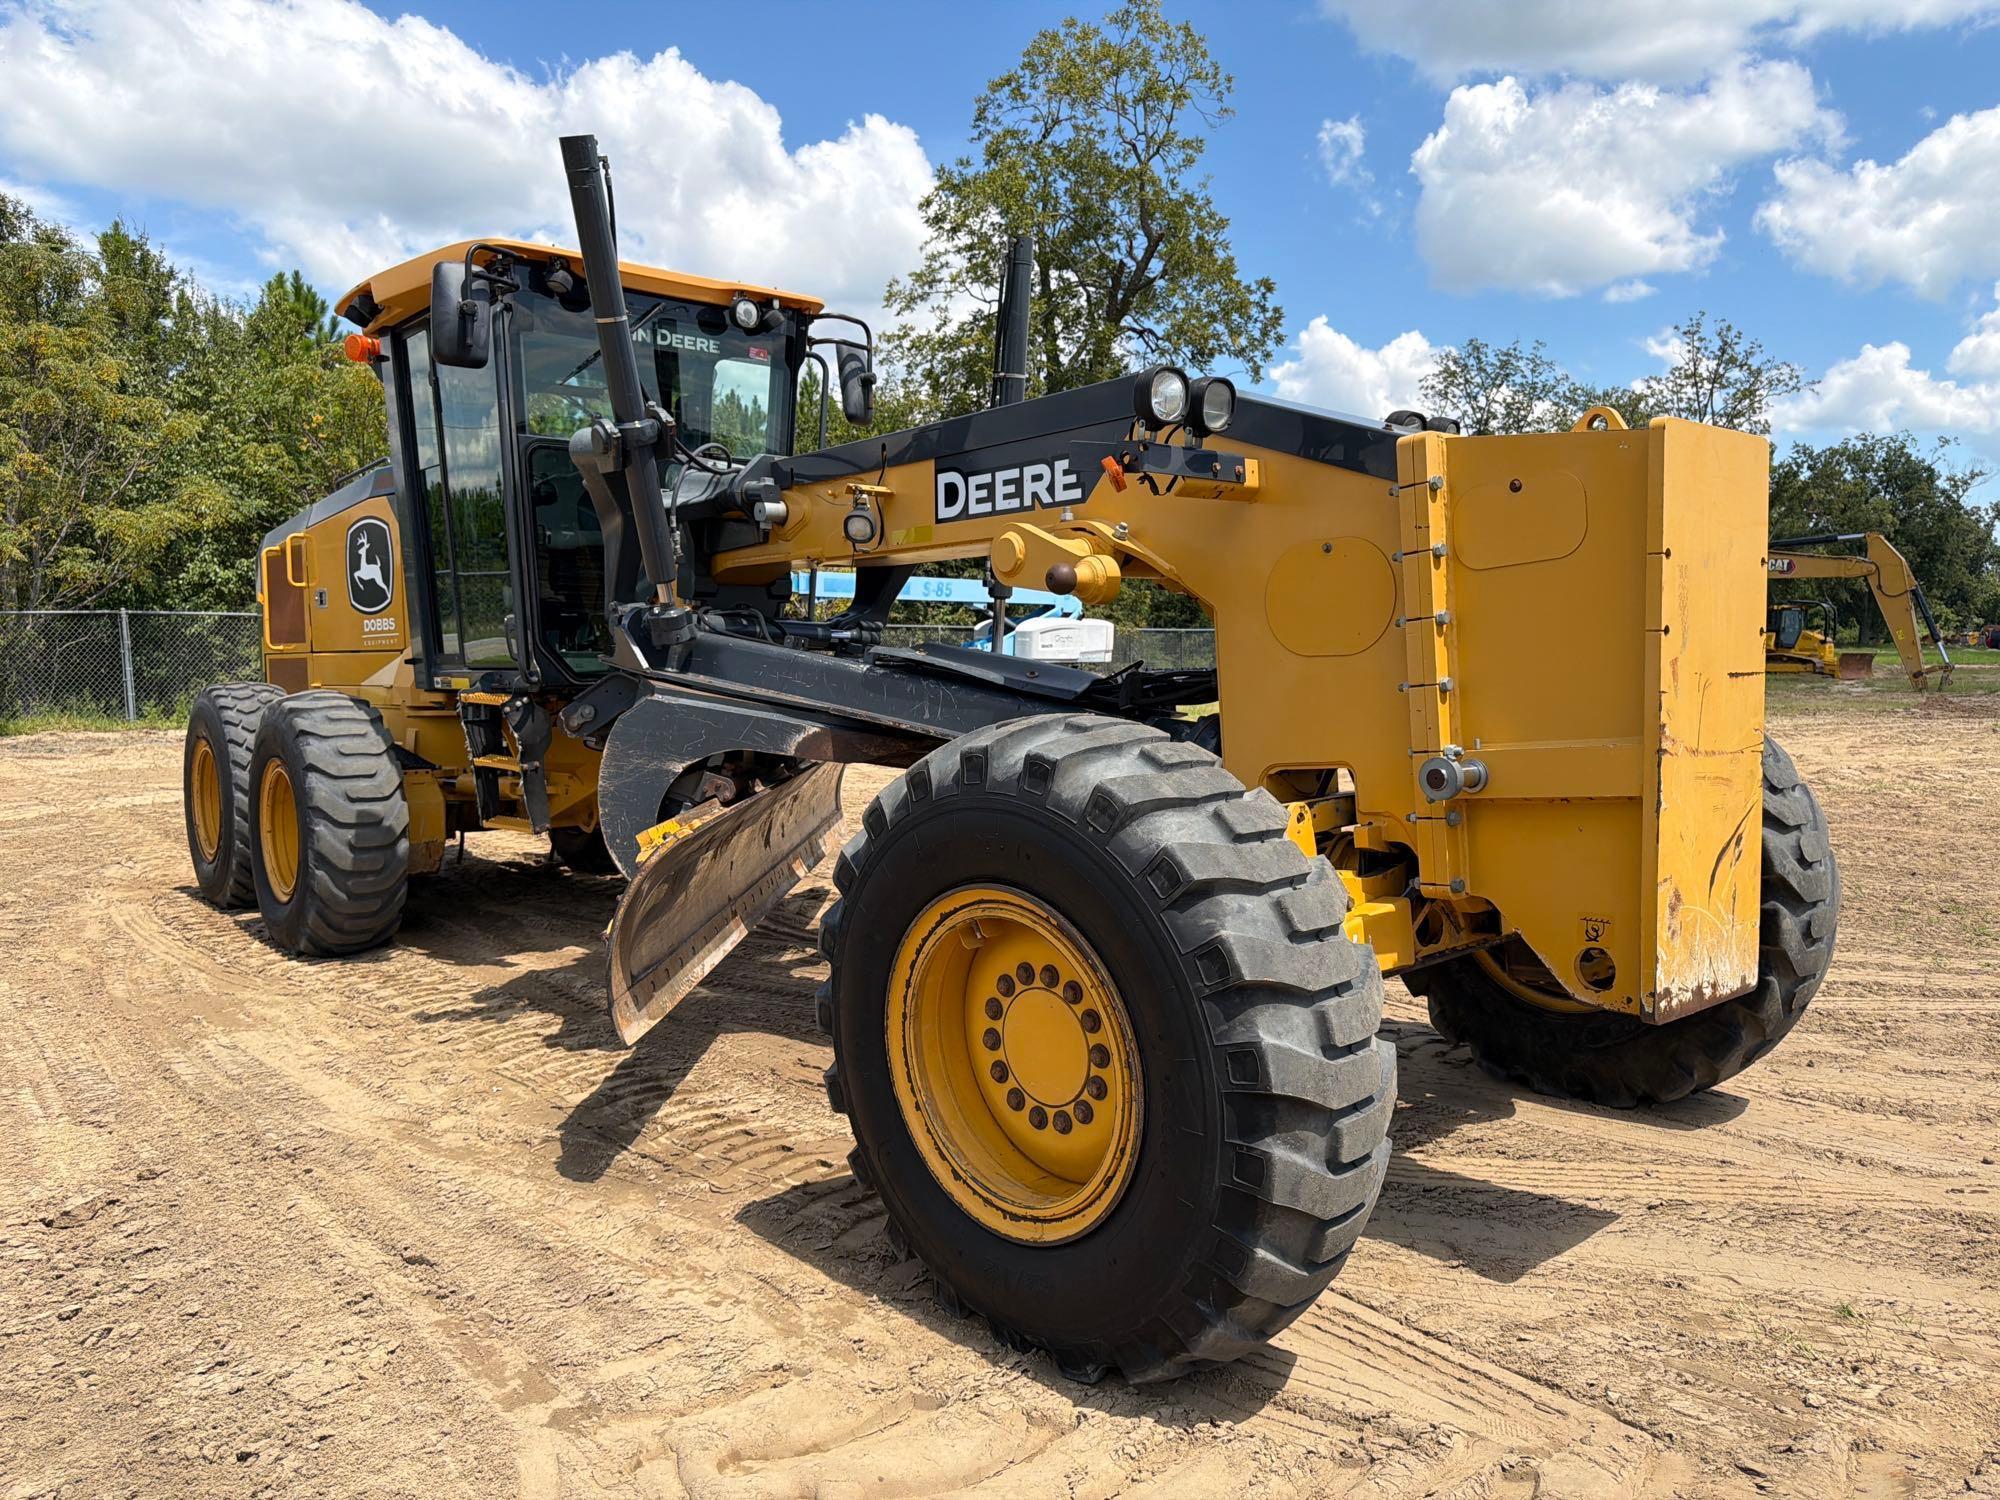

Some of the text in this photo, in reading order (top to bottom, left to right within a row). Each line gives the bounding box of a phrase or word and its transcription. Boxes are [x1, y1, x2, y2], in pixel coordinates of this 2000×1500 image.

[656, 328, 720, 354] DEERE
[937, 458, 1082, 519] DEERE
[1768, 559, 1790, 571] CAT
[922, 581, 952, 597] S-85
[363, 617, 396, 632] DOBBS
